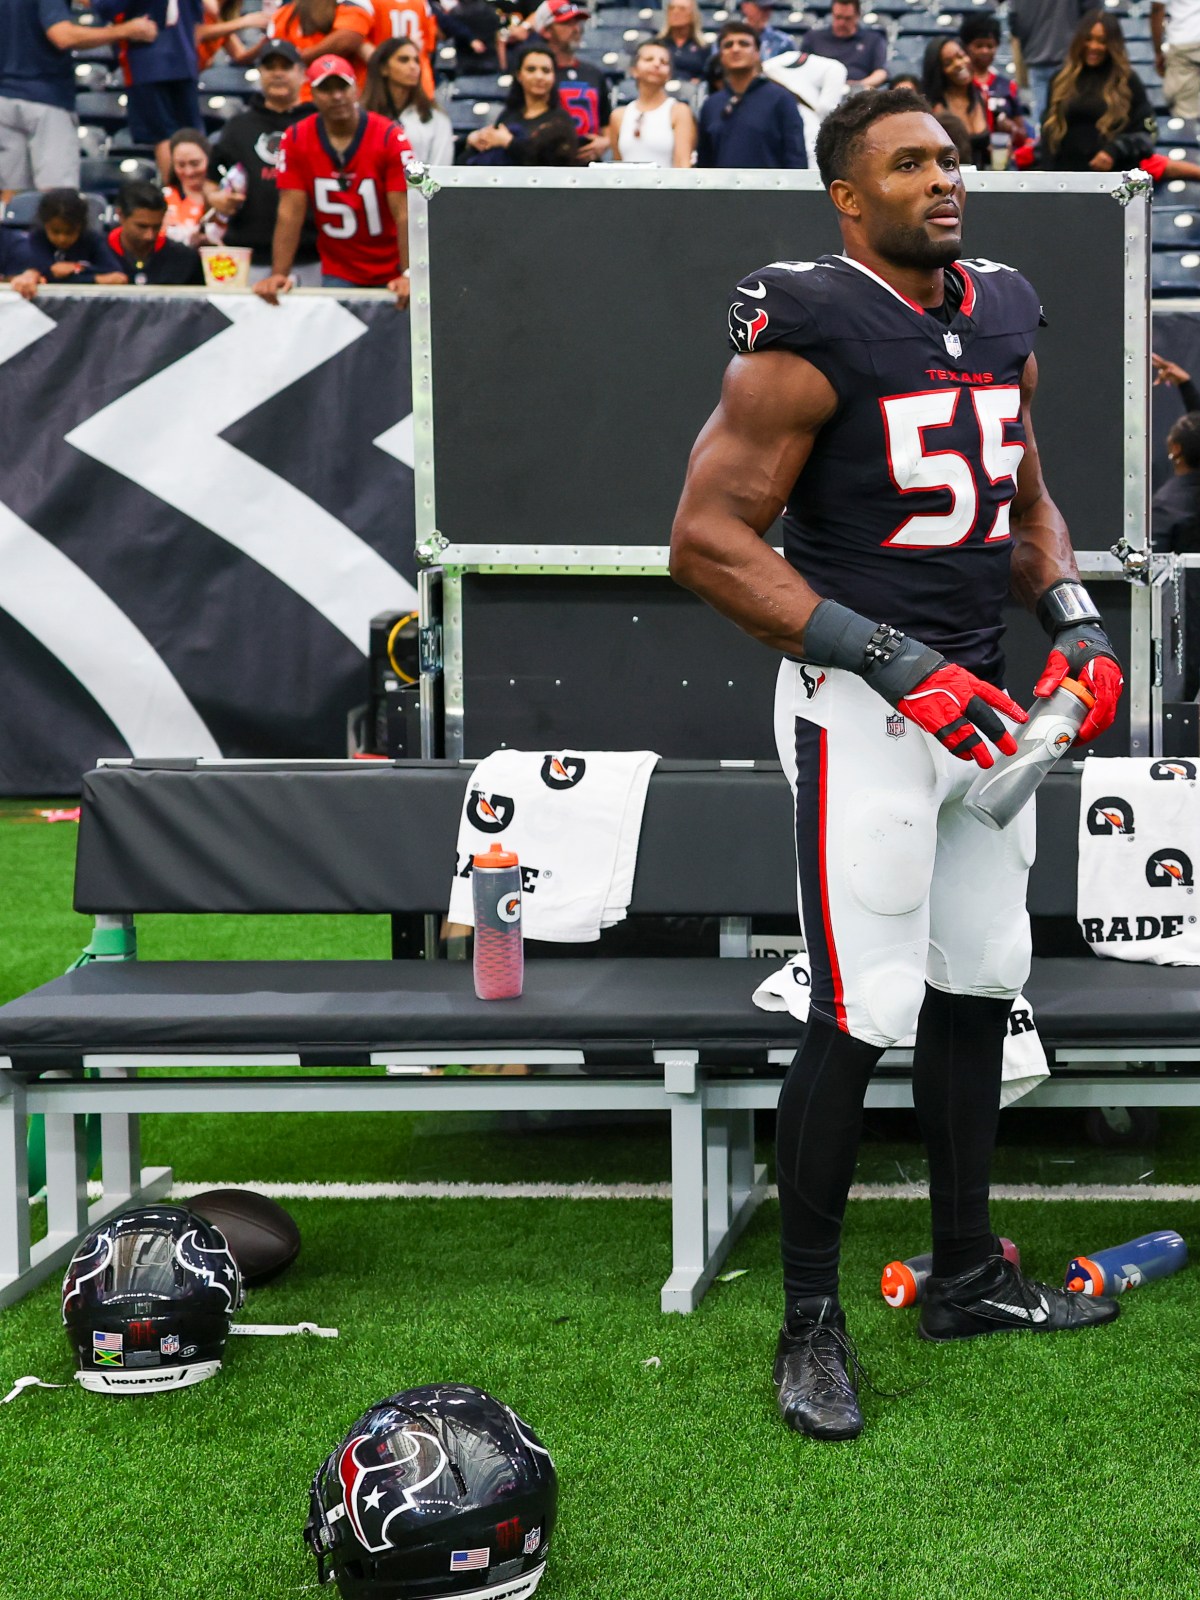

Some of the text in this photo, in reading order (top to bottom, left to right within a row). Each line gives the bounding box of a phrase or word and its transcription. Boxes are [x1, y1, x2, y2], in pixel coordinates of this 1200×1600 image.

[314, 176, 384, 239] 51
[924, 369, 994, 384] TEXANS
[878, 384, 1027, 549] 55
[888, 722, 905, 734] NFL
[111, 1375, 174, 1385] HOUSTON
